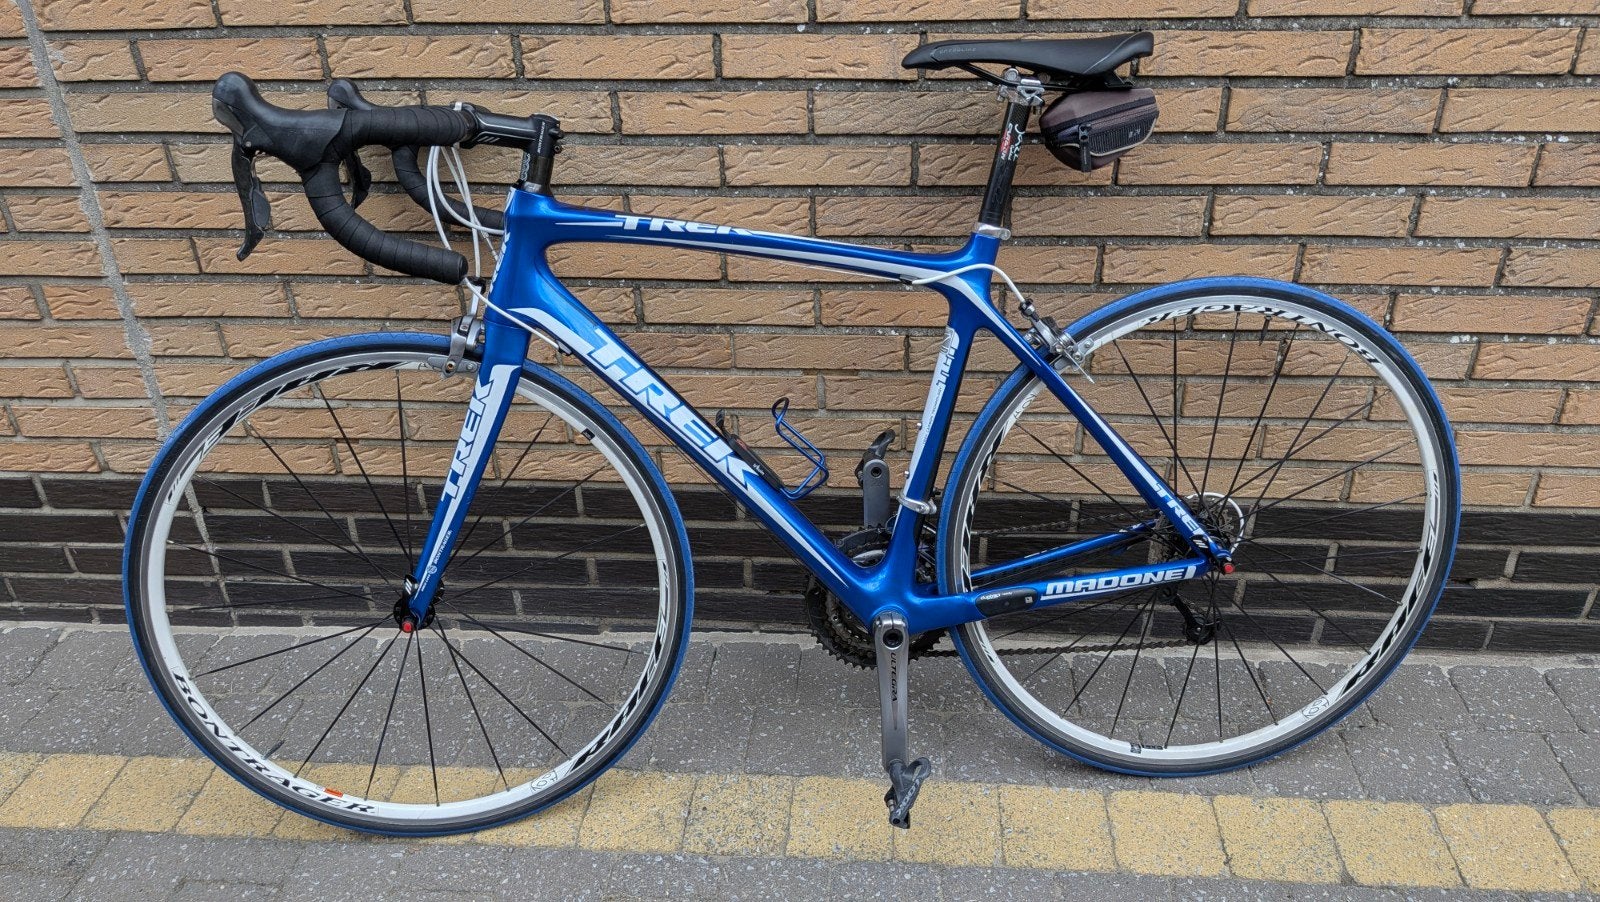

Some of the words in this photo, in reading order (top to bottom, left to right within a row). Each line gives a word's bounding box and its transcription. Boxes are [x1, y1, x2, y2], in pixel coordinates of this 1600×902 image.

[615, 214, 756, 236] TREK
[1142, 304, 1383, 365] BONTRAGER
[441, 374, 494, 501] TREK
[587, 327, 760, 490] TREK
[1045, 568, 1183, 596] MADONE
[889, 651, 899, 703] ULTEGRA
[172, 671, 377, 814] BONTRAGER
